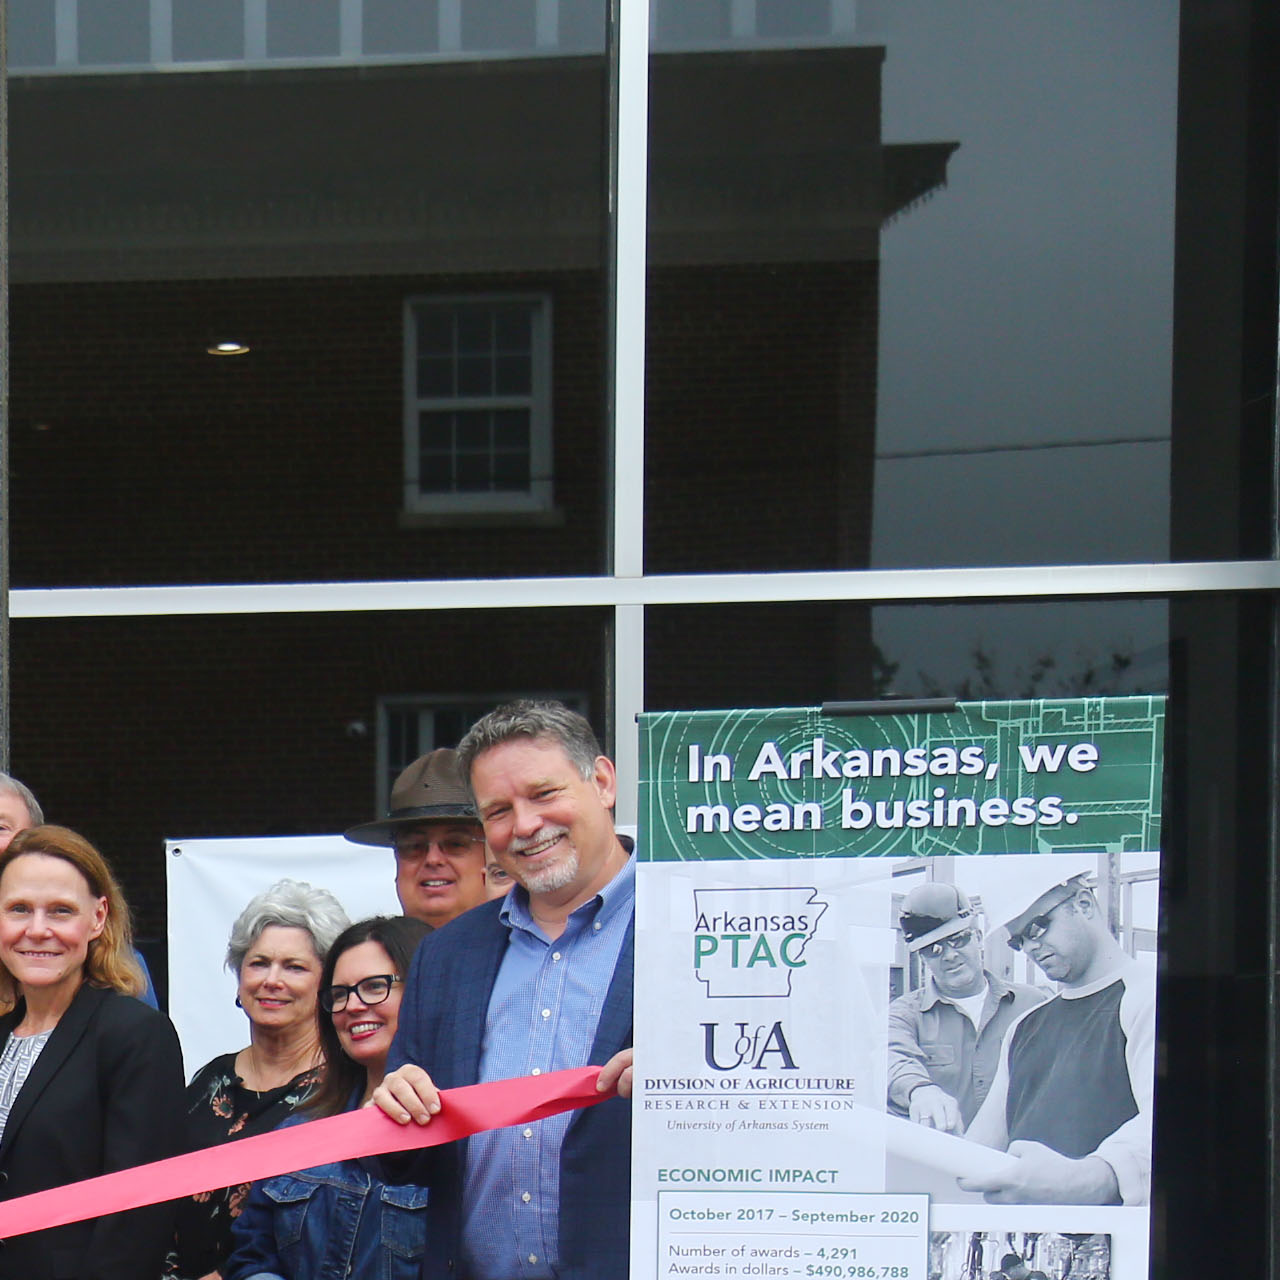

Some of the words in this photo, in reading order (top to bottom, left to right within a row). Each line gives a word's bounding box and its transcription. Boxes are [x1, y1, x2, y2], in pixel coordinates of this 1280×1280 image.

[686, 743, 731, 782] In
[747, 738, 998, 781] Arkansas,
[1018, 741, 1099, 773] we
[686, 800, 822, 834] mean
[840, 788, 1079, 830] business.
[694, 911, 808, 933] Arkansas
[692, 933, 808, 969] PTAC
[644, 1079, 714, 1089] DIVISION
[719, 1078, 740, 1089] OF
[744, 1078, 854, 1089] AGRICULTURE
[644, 1100, 729, 1110] RESEARCH
[737, 1100, 750, 1109] &
[759, 1100, 853, 1110] EXTENSION
[667, 1120, 722, 1131] University
[726, 1120, 736, 1132] of
[739, 1120, 788, 1130] Arkansas
[792, 1120, 829, 1132] System
[658, 1169, 762, 1182] ECONOMIC
[769, 1169, 838, 1183] IMPACT
[669, 1208, 732, 1220] October
[736, 1208, 774, 1220] 2017
[792, 1209, 875, 1224] September
[880, 1211, 918, 1223] 2020
[669, 1244, 726, 1256] Number
[731, 1244, 745, 1257] of
[750, 1246, 799, 1257] awards
[816, 1247, 856, 1260] 4,291
[668, 1262, 720, 1274] Awards
[725, 1263, 736, 1274] in
[742, 1262, 788, 1275] dollars
[806, 1265, 908, 1279] $490,986,788
